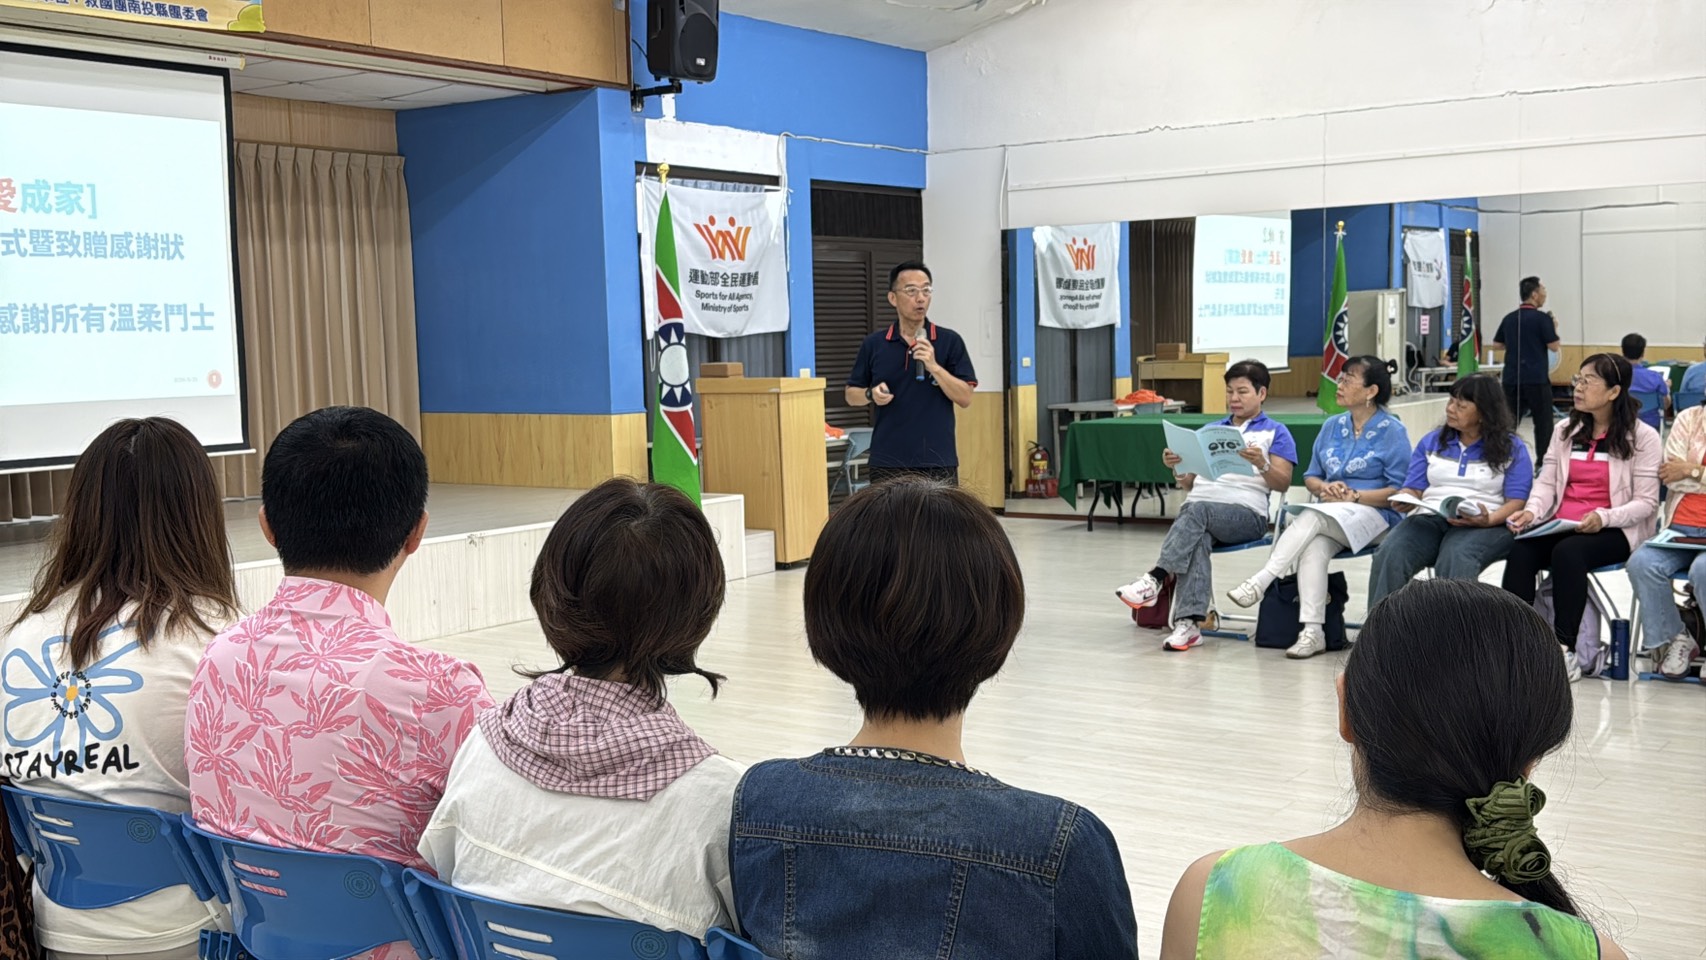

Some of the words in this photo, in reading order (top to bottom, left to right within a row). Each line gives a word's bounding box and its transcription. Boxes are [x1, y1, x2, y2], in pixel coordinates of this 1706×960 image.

[695, 289, 718, 300] Sports
[719, 291, 728, 301] for
[728, 292, 736, 301] All
[701, 302, 728, 314] Ministry
[727, 303, 734, 312] of
[733, 303, 750, 314] Sports
[52, 671, 71, 689] KEEP
[4, 742, 140, 780] STAYREAL
